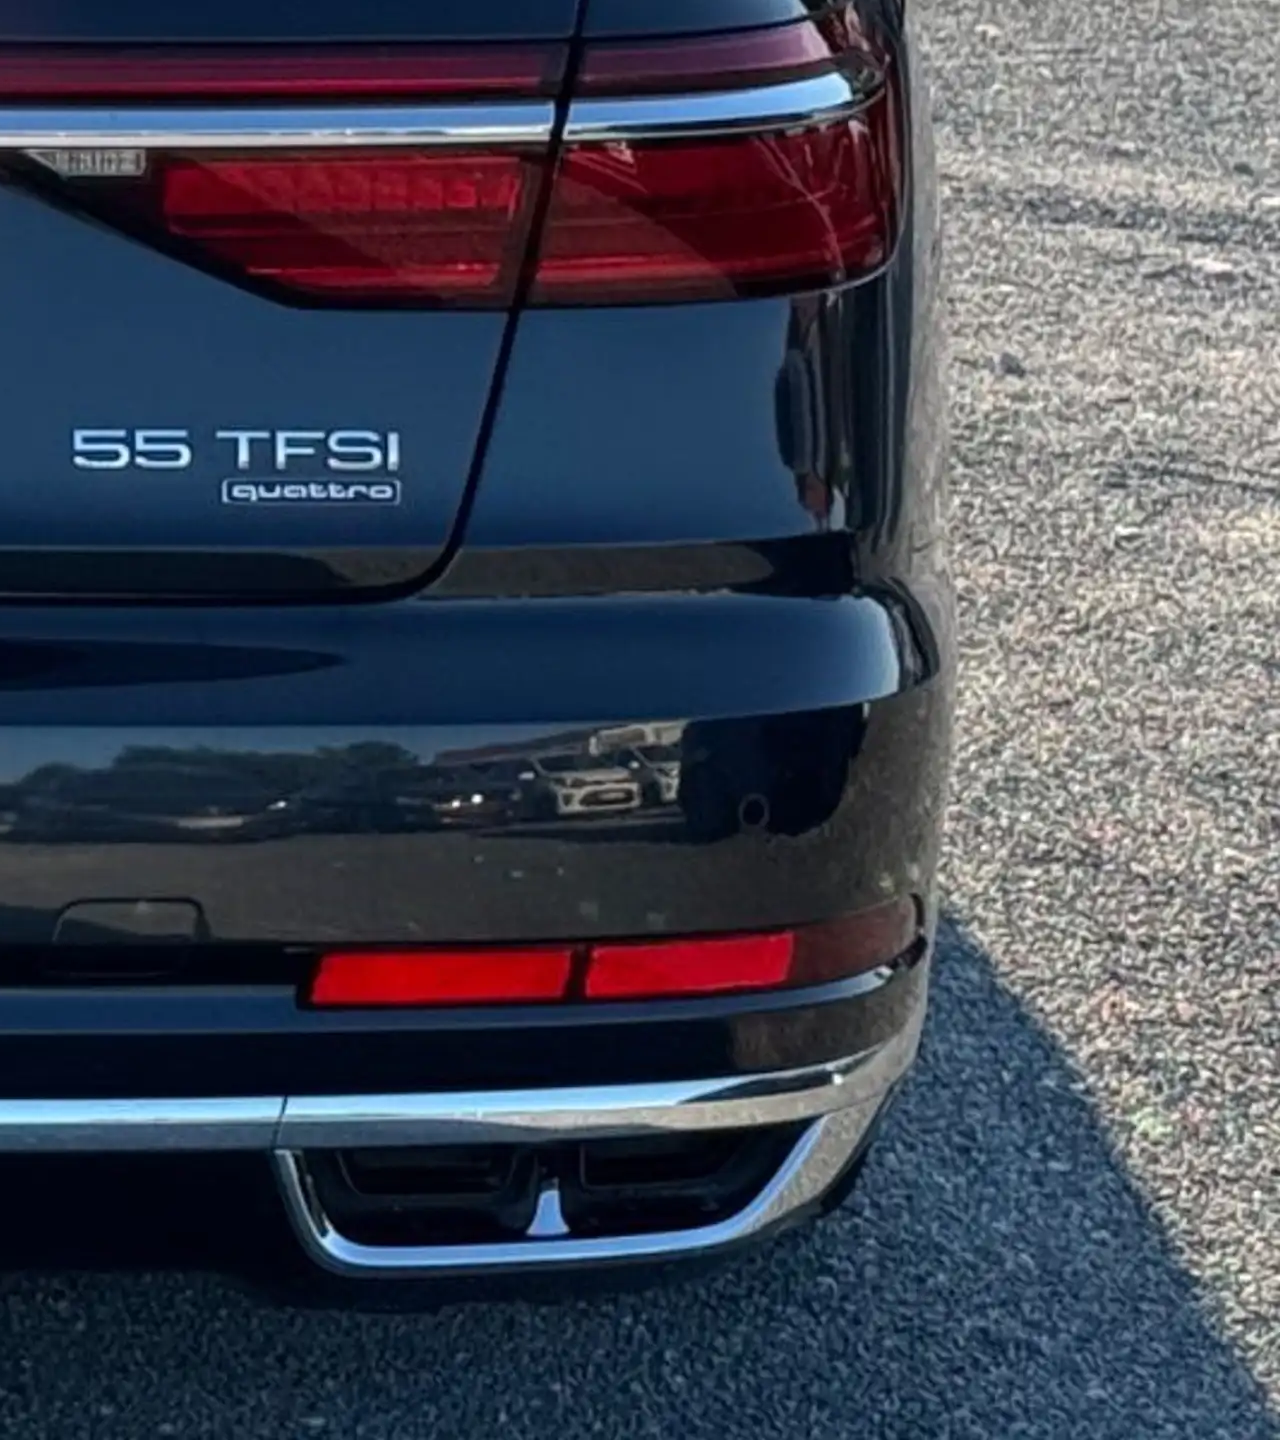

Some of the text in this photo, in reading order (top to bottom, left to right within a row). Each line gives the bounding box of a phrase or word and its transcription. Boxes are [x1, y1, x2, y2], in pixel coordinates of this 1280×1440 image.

[73, 429, 400, 471] 55 TFSI
[231, 482, 394, 502] quattro
